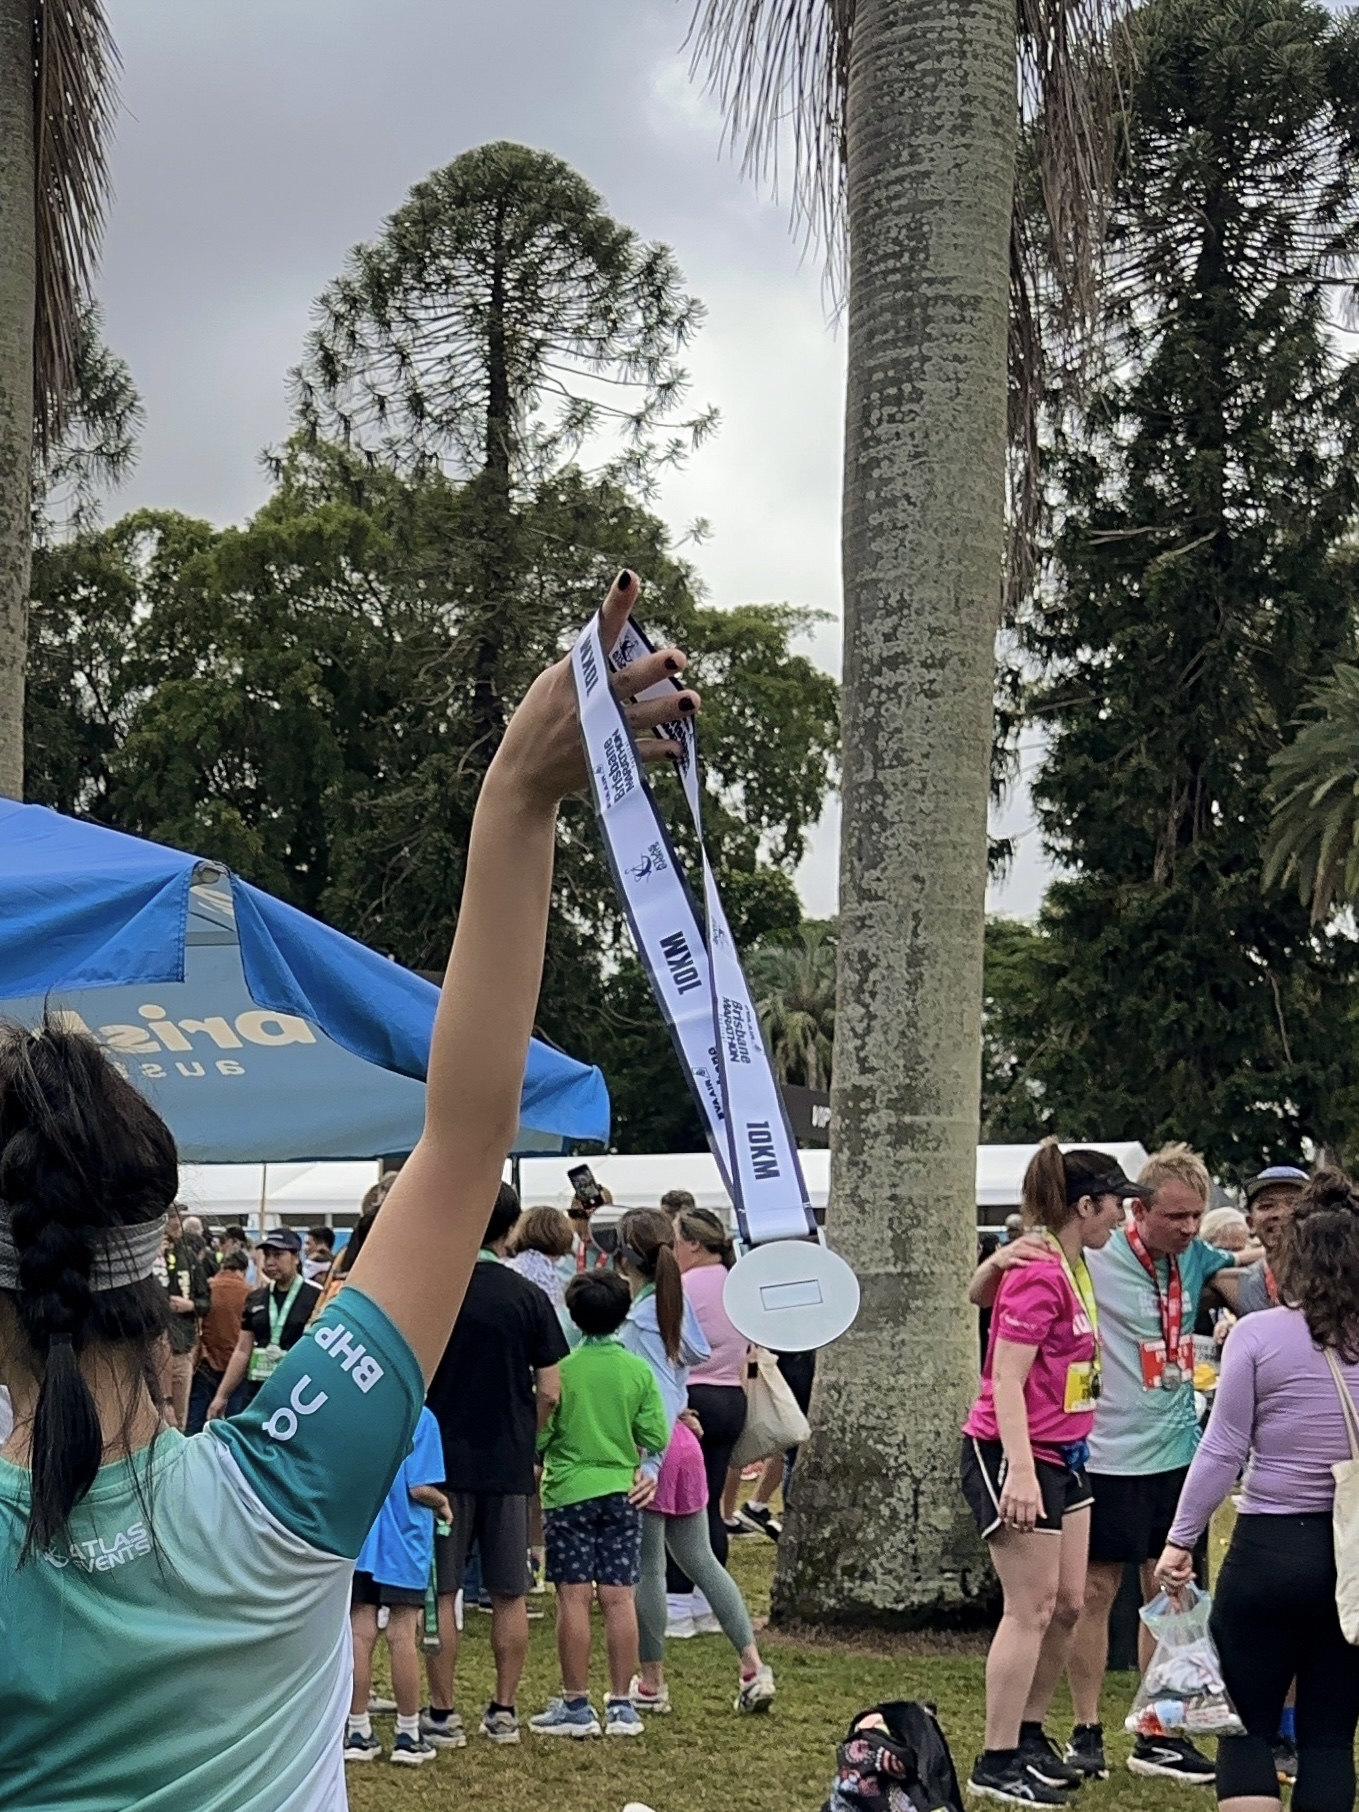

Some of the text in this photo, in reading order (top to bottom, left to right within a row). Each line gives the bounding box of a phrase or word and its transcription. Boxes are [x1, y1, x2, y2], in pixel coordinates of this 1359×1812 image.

[603, 737, 626, 805] Brisbane
[659, 930, 703, 996] 10KM
[731, 999, 752, 1065] Brisbane
[746, 1120, 781, 1181] 10KM
[314, 1323, 385, 1394] BHP
[69, 1521, 148, 1560] ATLAS
